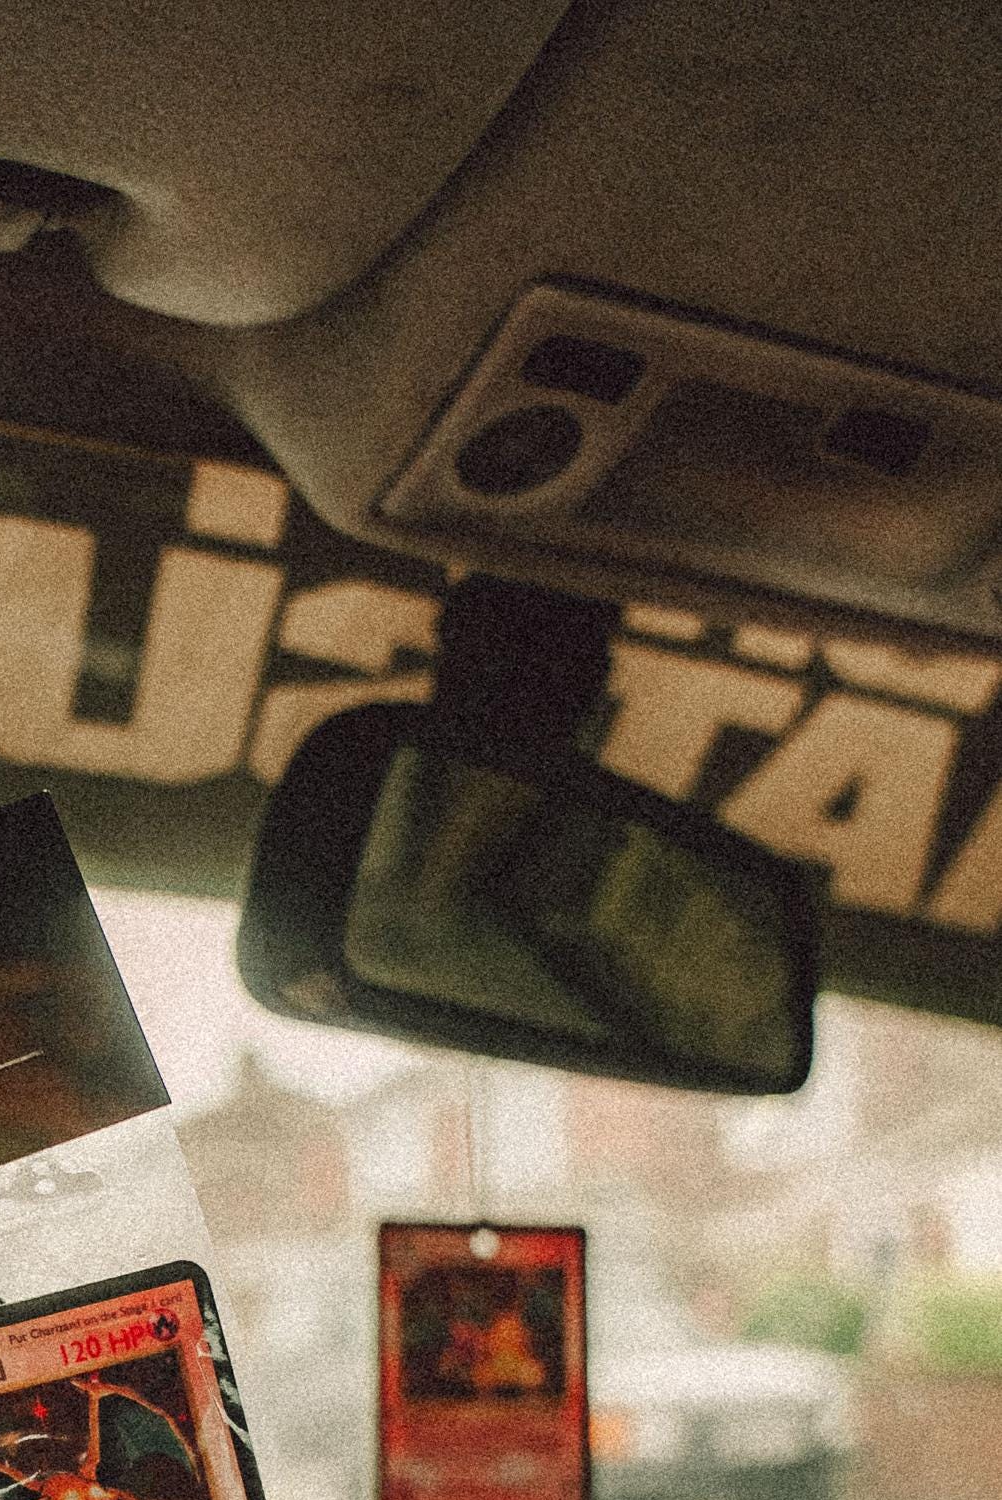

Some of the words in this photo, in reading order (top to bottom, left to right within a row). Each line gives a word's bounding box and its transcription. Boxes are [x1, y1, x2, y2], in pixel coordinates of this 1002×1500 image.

[9, 1332, 27, 1344] Put
[30, 1319, 81, 1339] Charizard
[83, 1316, 99, 1325] on
[100, 1309, 117, 1321] the
[159, 1292, 183, 1305] card
[58, 1336, 103, 1365] 120
[107, 1325, 147, 1352] HP
